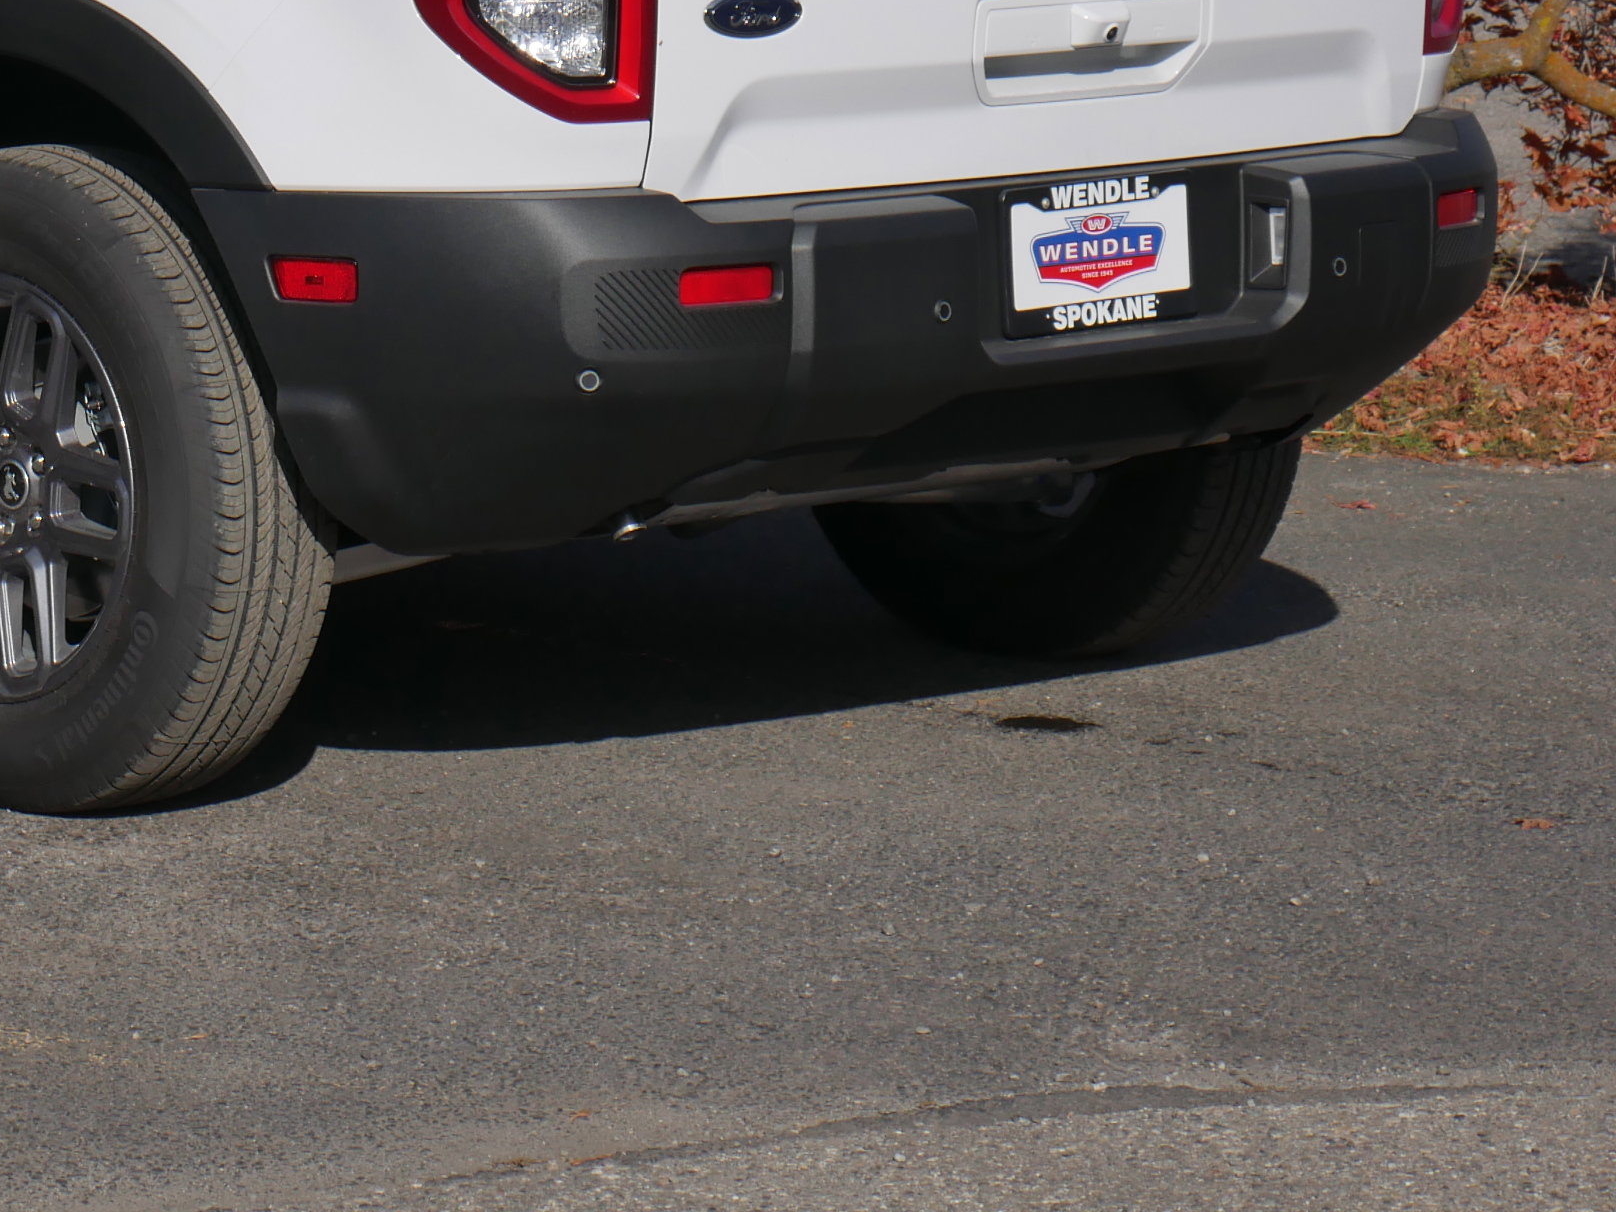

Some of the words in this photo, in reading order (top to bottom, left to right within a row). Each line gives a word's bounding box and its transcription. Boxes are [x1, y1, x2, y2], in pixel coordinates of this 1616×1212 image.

[1051, 175, 1150, 210] WENDLE
[1087, 217, 1106, 231] W
[1039, 234, 1153, 262] WENDLE
[1060, 263, 1096, 273] AUTOMOTIVE
[1097, 260, 1133, 269] EXCELLENCE
[1082, 271, 1099, 279] SINCE
[1053, 294, 1157, 331] SPOKANE
